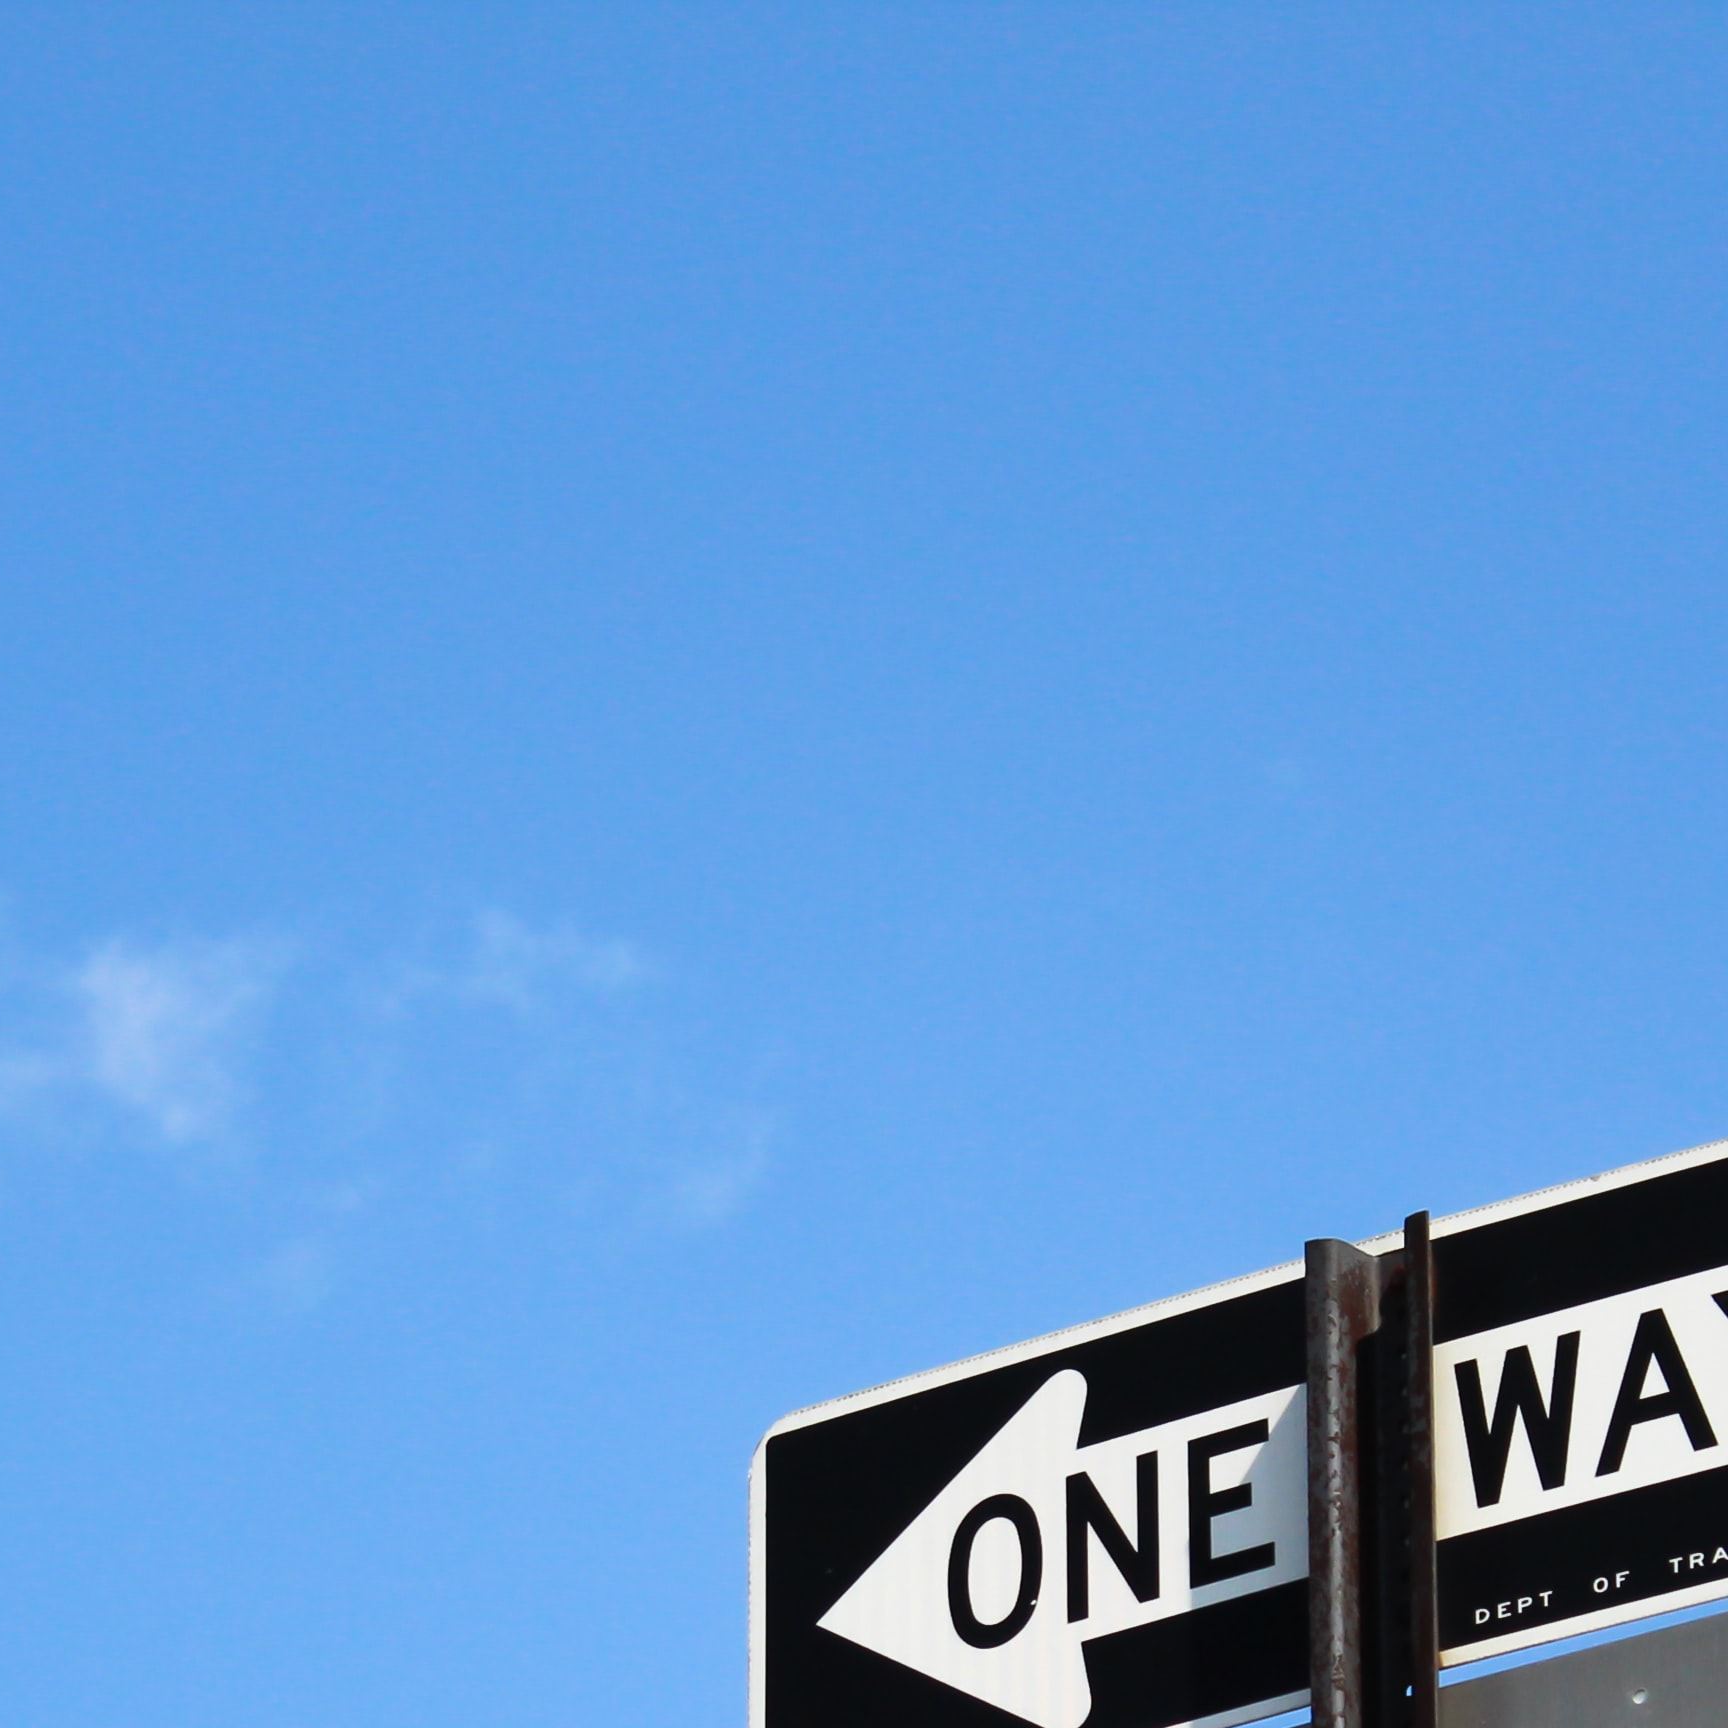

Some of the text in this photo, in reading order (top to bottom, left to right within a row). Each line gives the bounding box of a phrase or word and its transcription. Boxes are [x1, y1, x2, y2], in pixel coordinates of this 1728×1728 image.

[947, 1418, 1276, 1650] ONE
[1474, 1590, 1554, 1625] DEPT
[1592, 1570, 1631, 1594] OF
